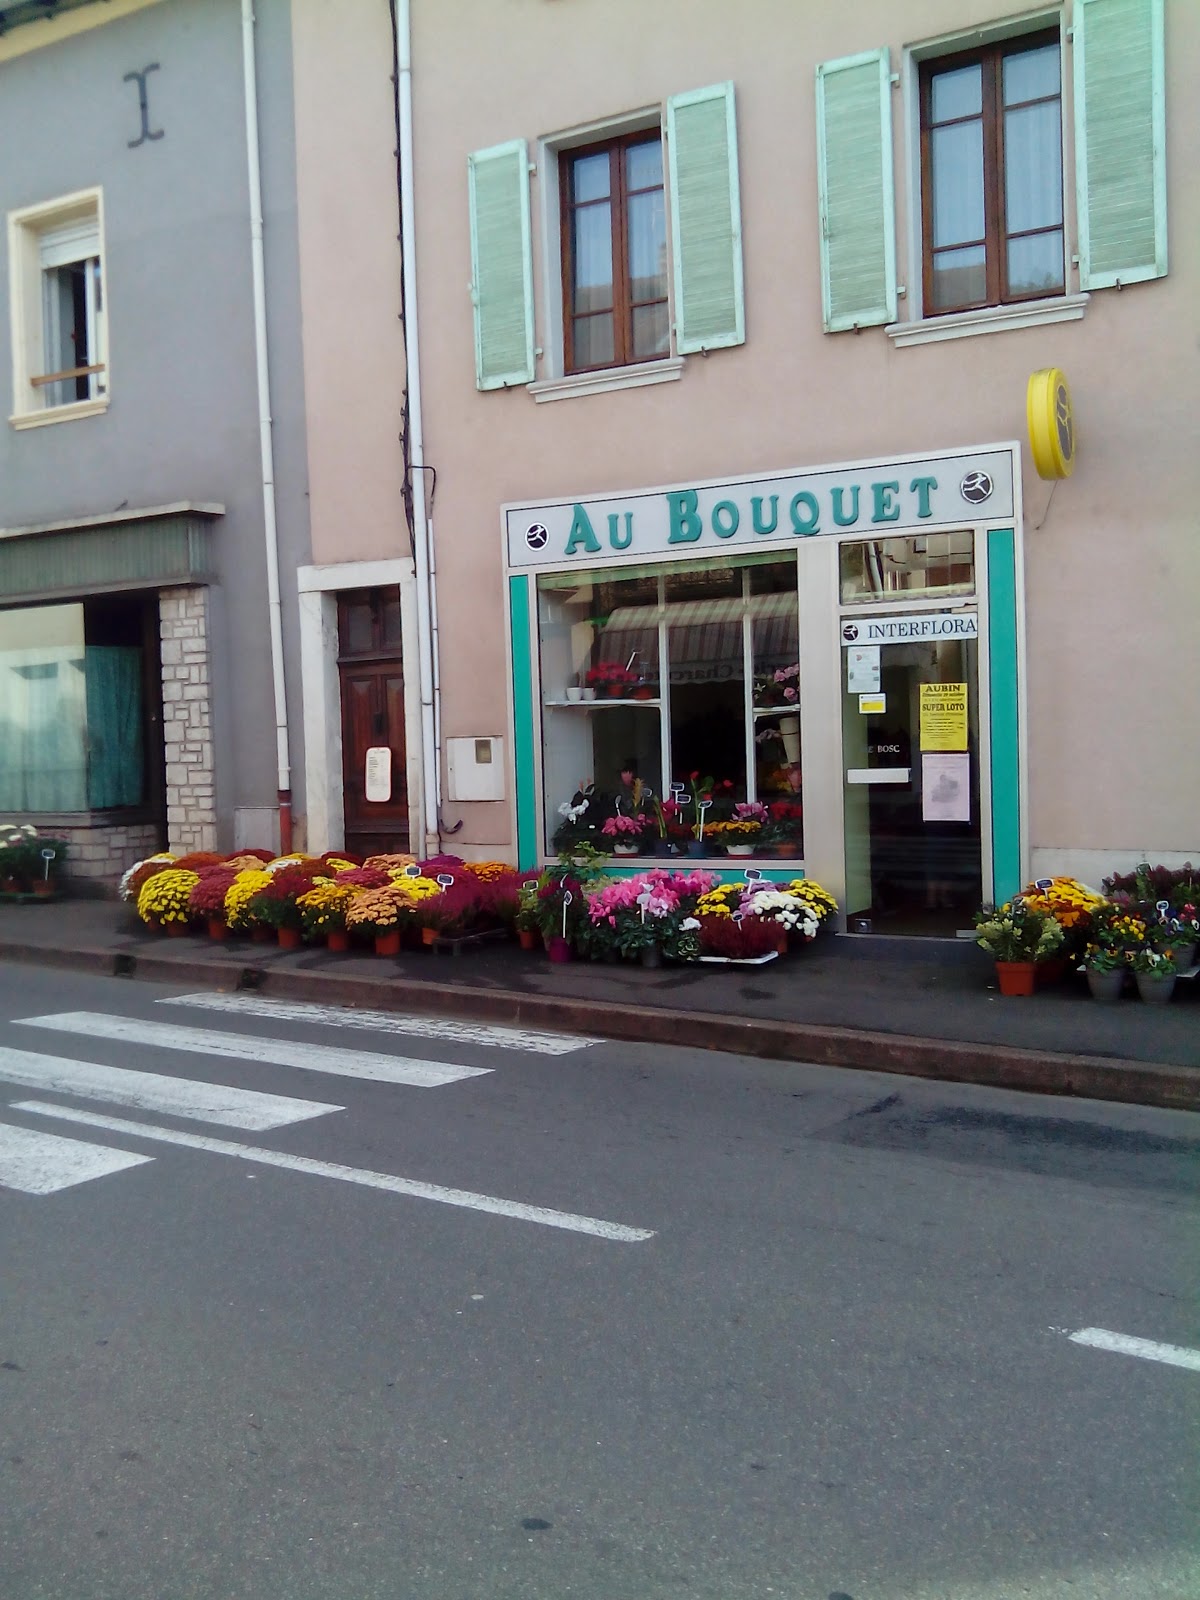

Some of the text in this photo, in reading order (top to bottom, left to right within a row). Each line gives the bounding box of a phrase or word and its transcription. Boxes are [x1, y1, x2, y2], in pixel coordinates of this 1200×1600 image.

[564, 475, 937, 555] AU BOUQUET
[868, 619, 976, 639] INTERFLORA
[925, 684, 961, 692] AUBIN
[922, 702, 965, 711] SUPER LOTO
[877, 744, 900, 753] BOSC
